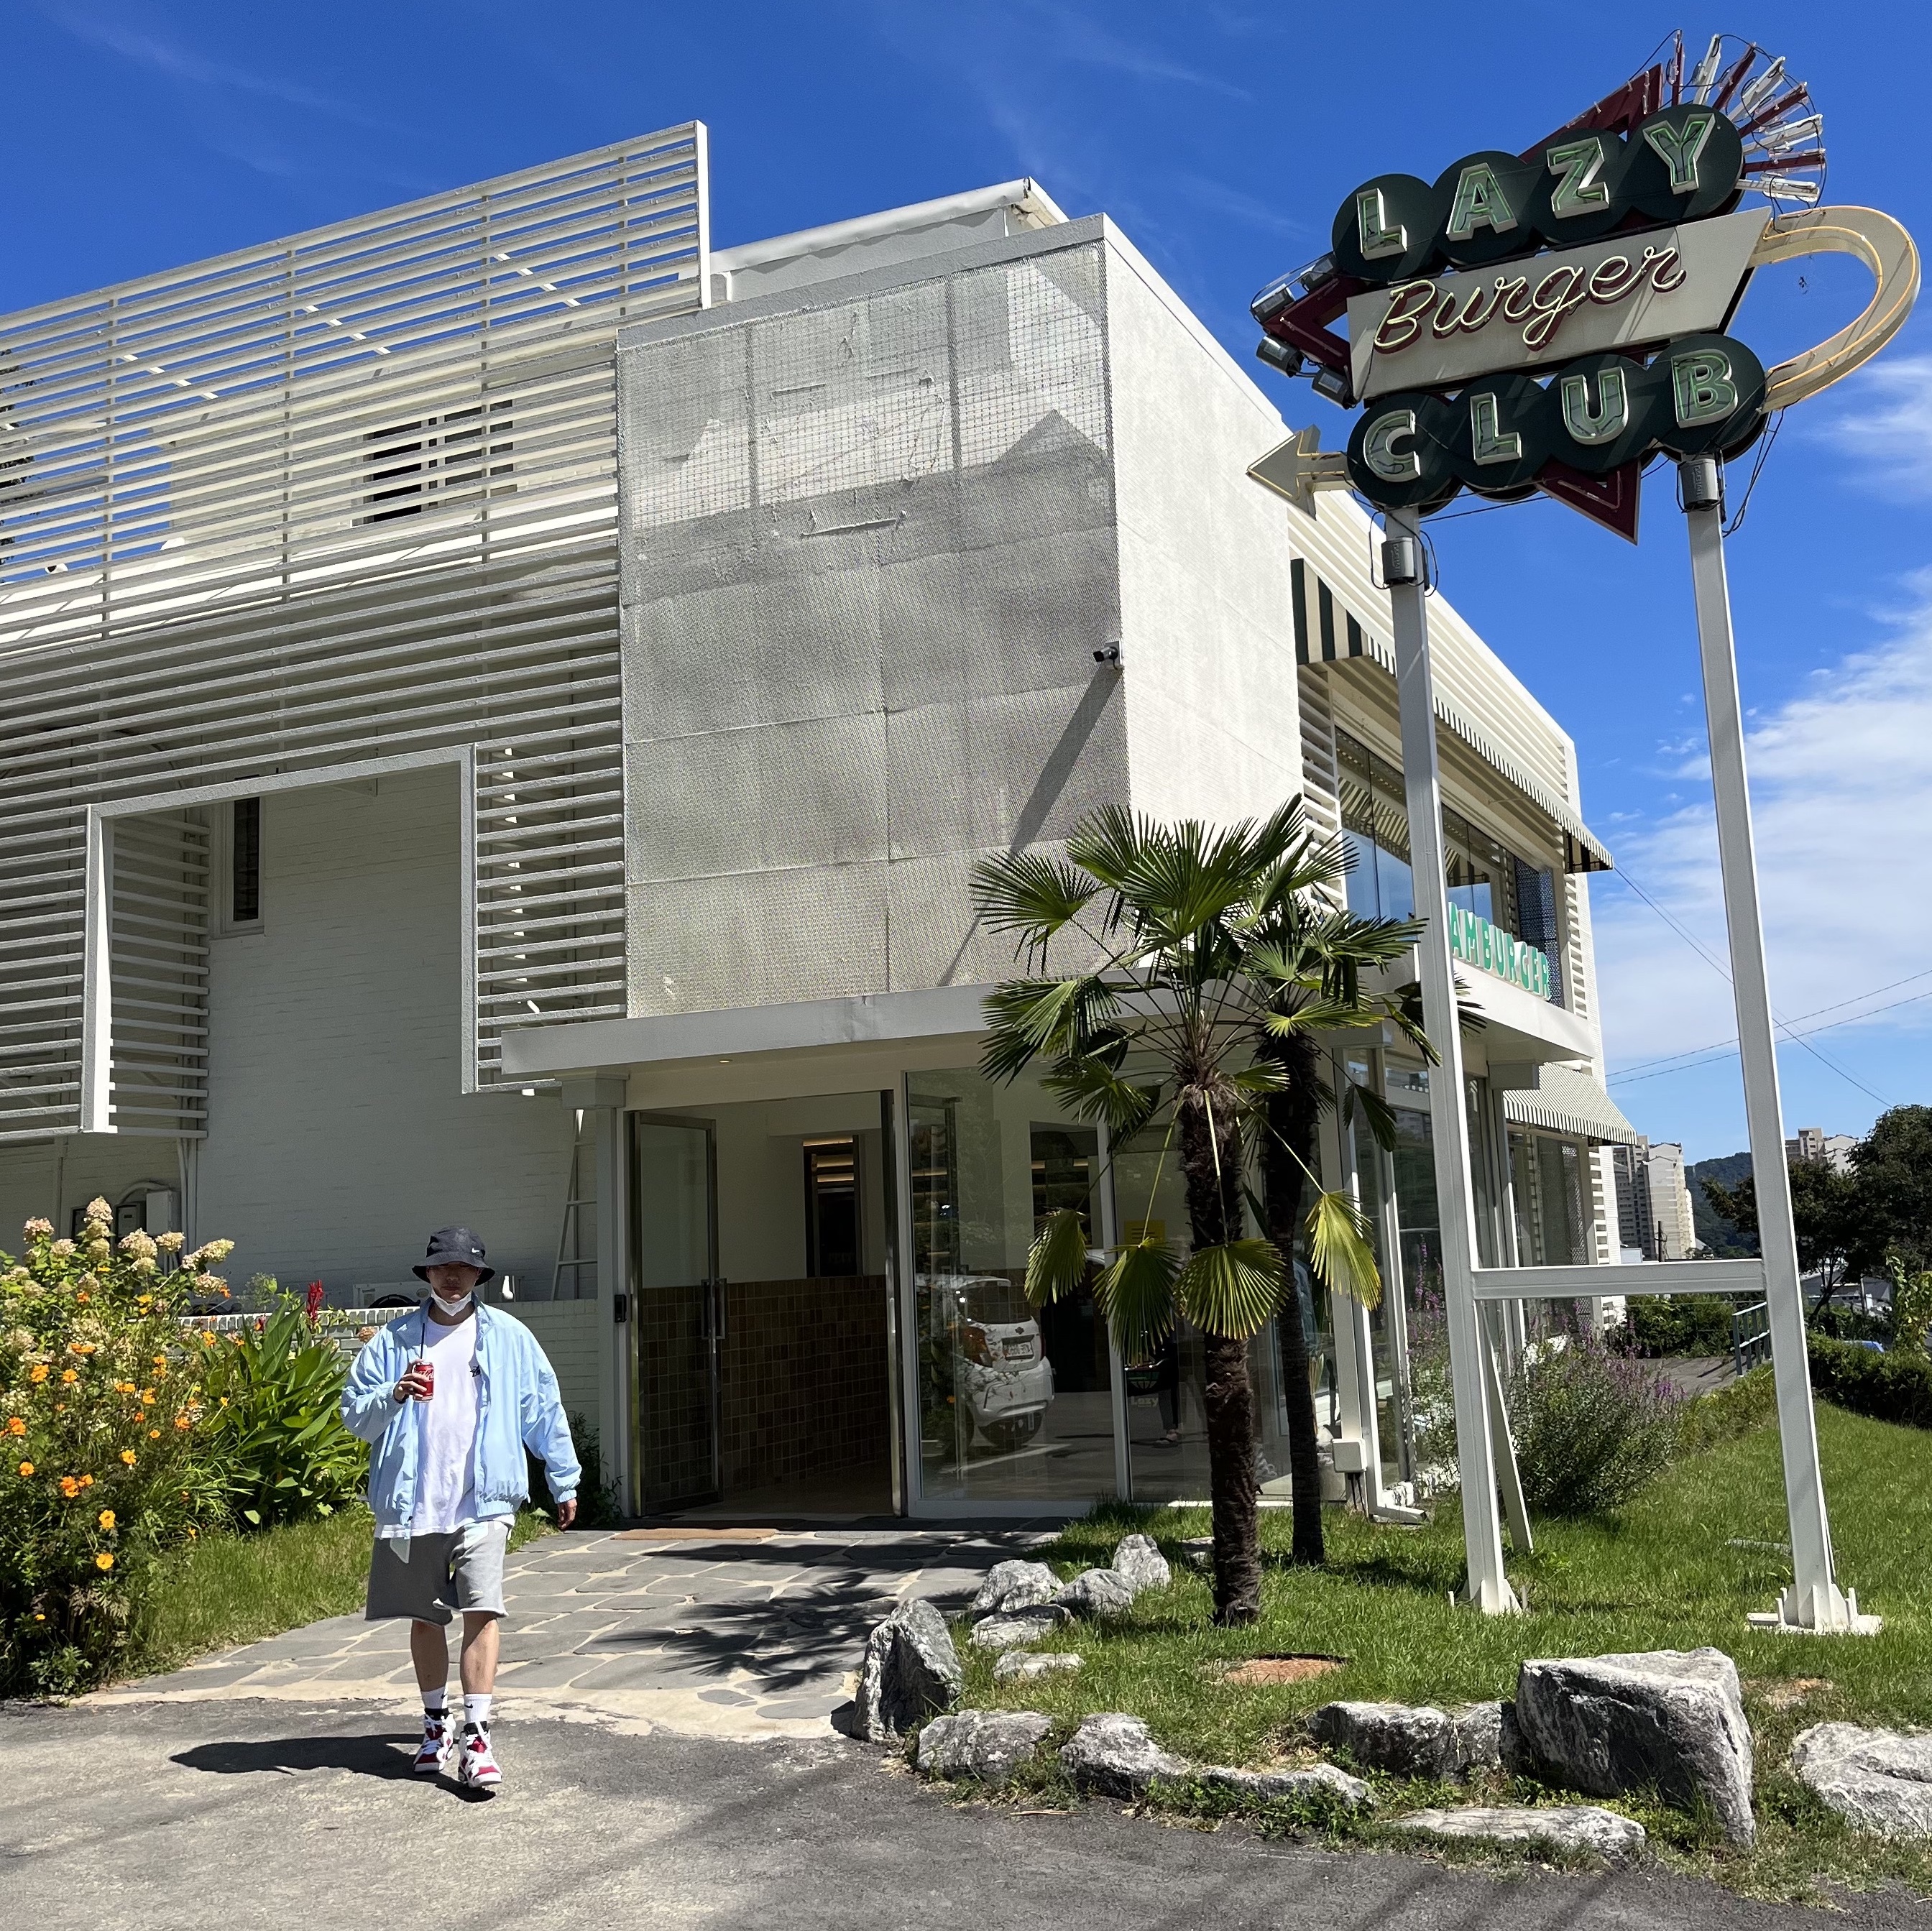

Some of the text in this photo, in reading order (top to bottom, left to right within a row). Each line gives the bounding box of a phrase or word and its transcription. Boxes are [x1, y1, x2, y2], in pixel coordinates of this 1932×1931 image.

[1356, 113, 1716, 260] LAZY
[1374, 246, 1687, 354] Burger
[1363, 349, 1739, 482] CLUB
[1448, 901, 1552, 1001] AMBURGER
